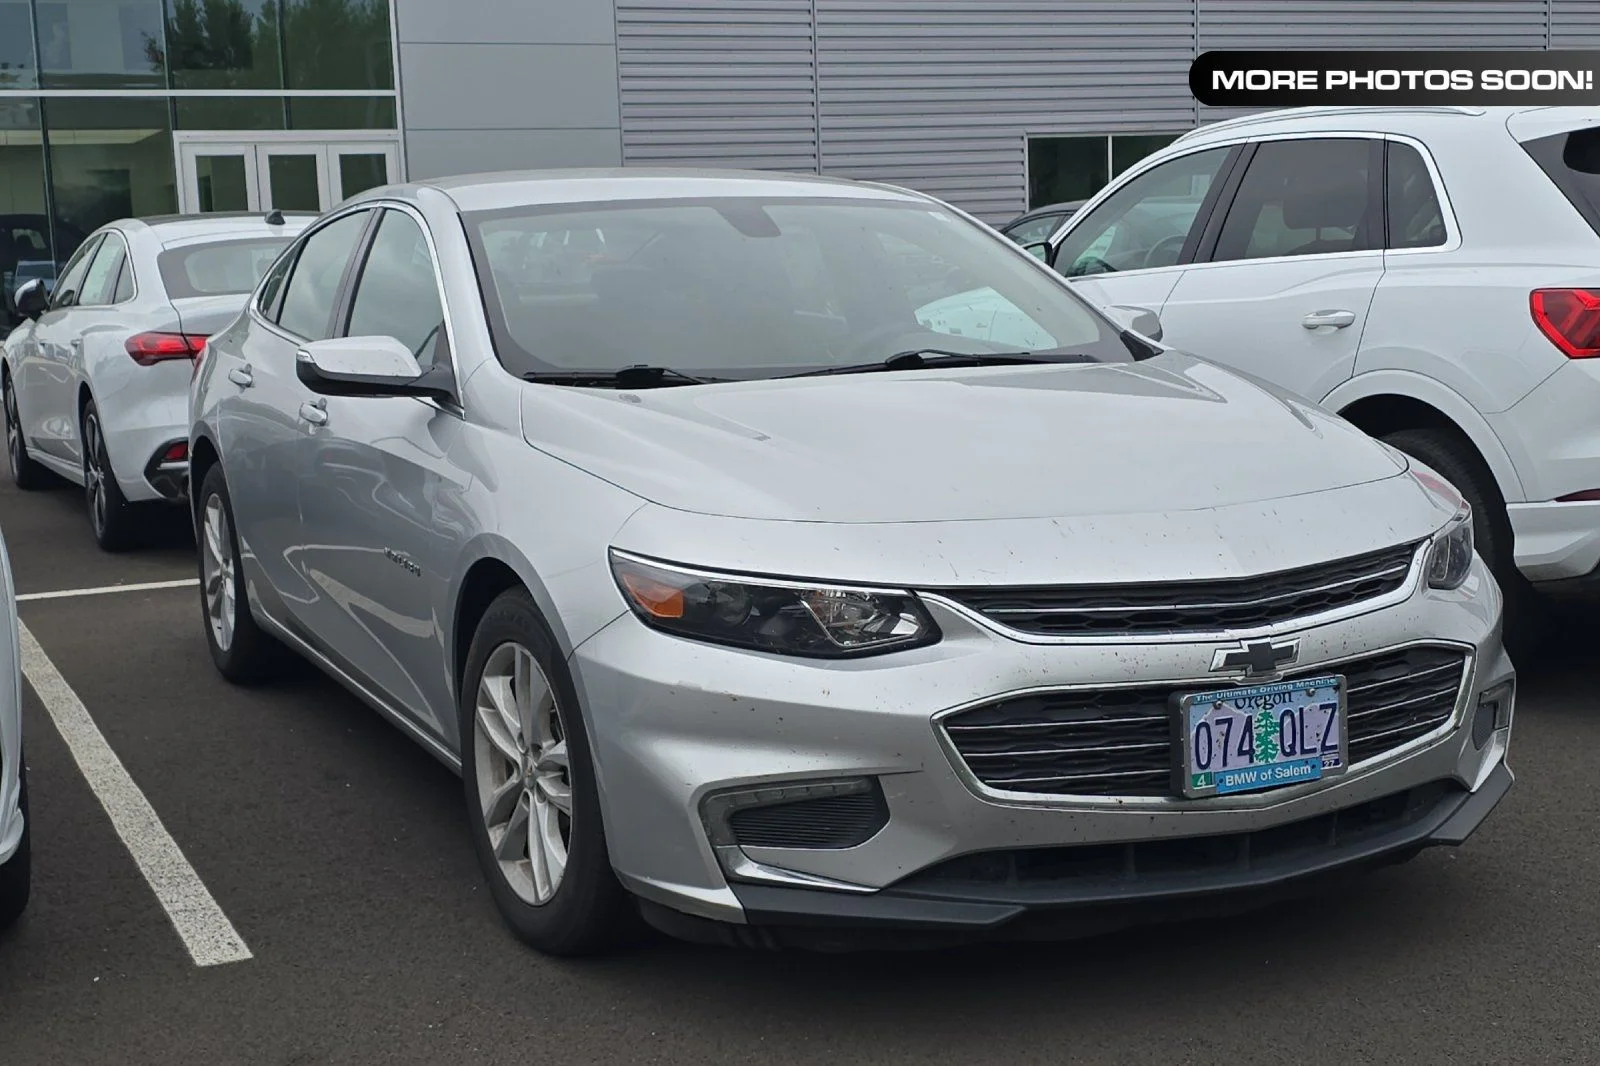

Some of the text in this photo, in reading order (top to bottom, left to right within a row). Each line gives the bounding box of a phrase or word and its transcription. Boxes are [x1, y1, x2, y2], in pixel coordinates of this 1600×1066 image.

[1196, 678, 1336, 702] The Ultimate Driving Machine
[1235, 692, 1293, 710] Oregon
[1195, 702, 1338, 770] 074 QLZ
[1197, 776, 1206, 786] 4
[1225, 764, 1311, 787] BMW of Salem
